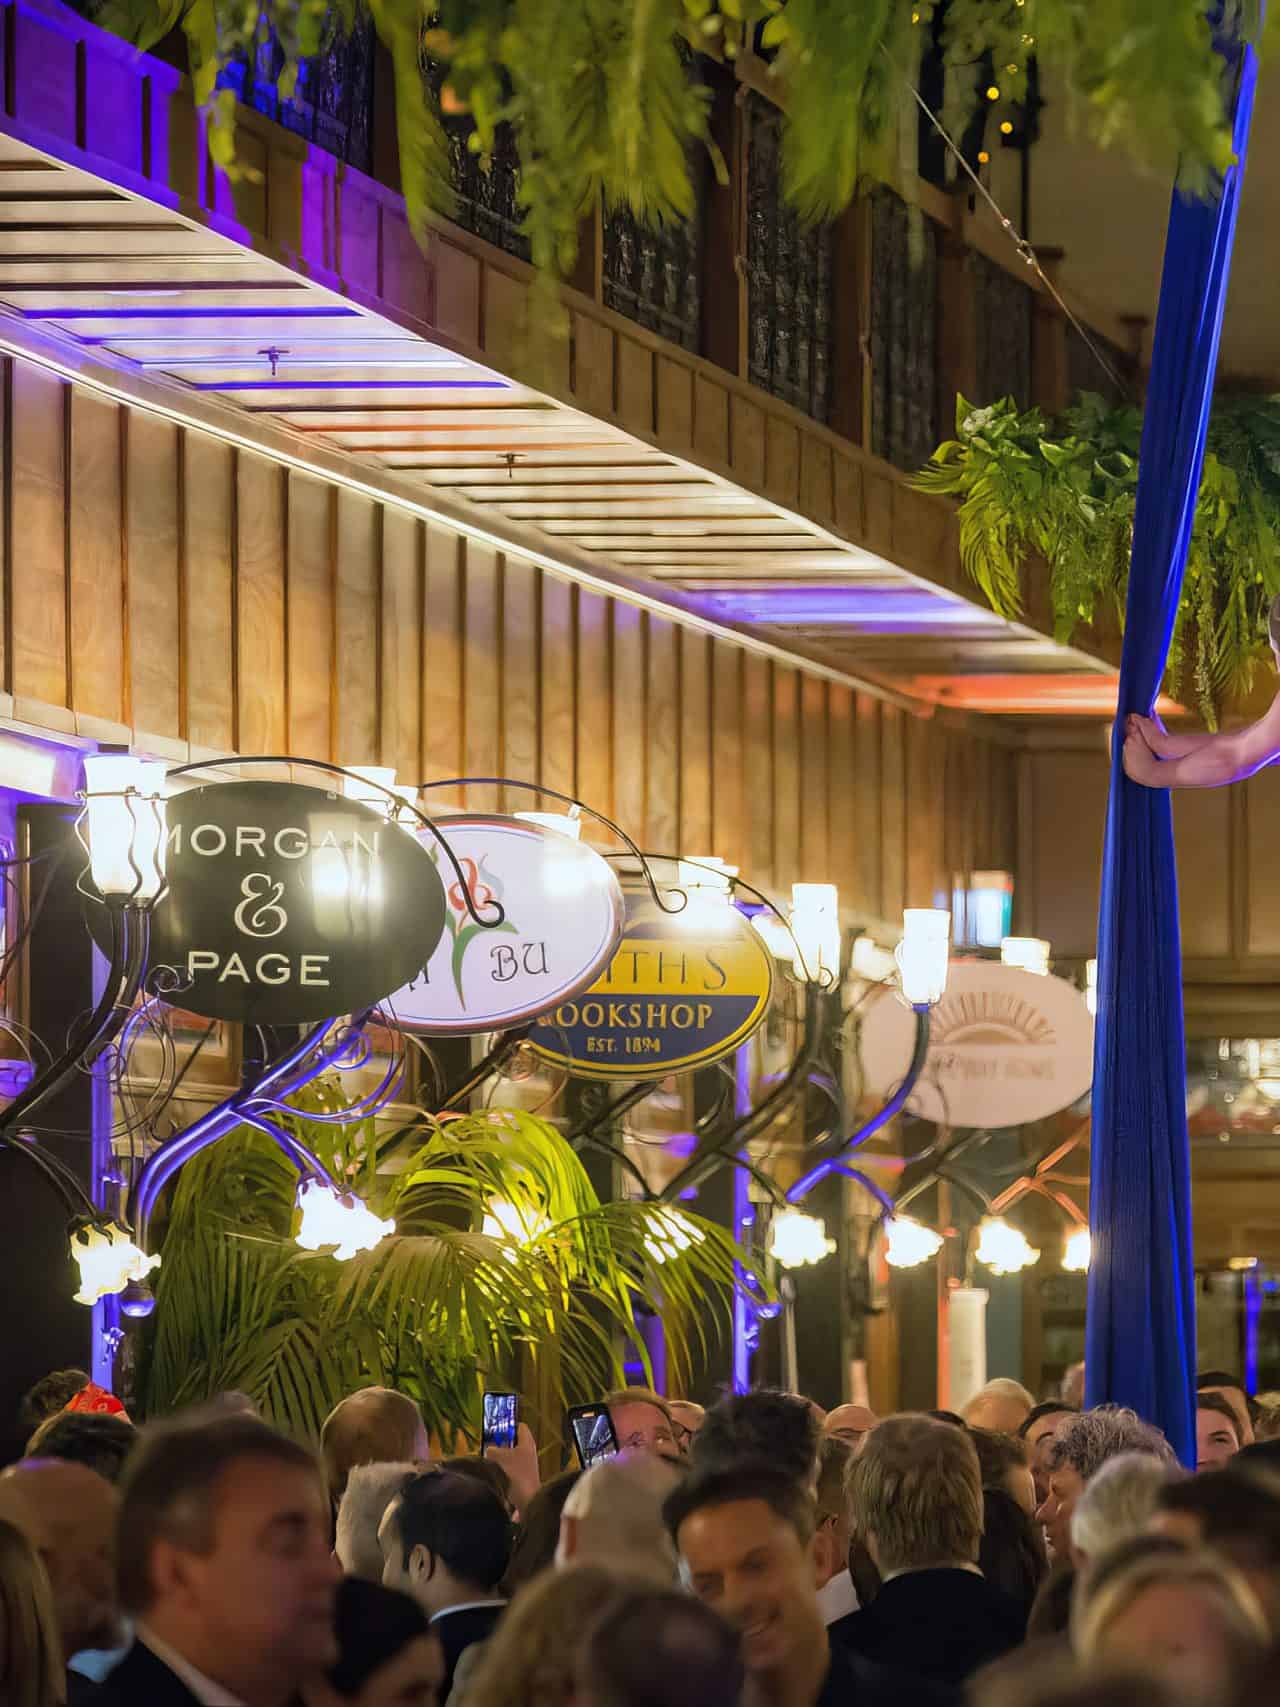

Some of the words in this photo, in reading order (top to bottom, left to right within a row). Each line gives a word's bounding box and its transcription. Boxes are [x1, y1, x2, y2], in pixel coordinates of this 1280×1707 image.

[234, 872, 288, 937] &
[187, 951, 330, 986] PAGE
[490, 942, 550, 982] BU
